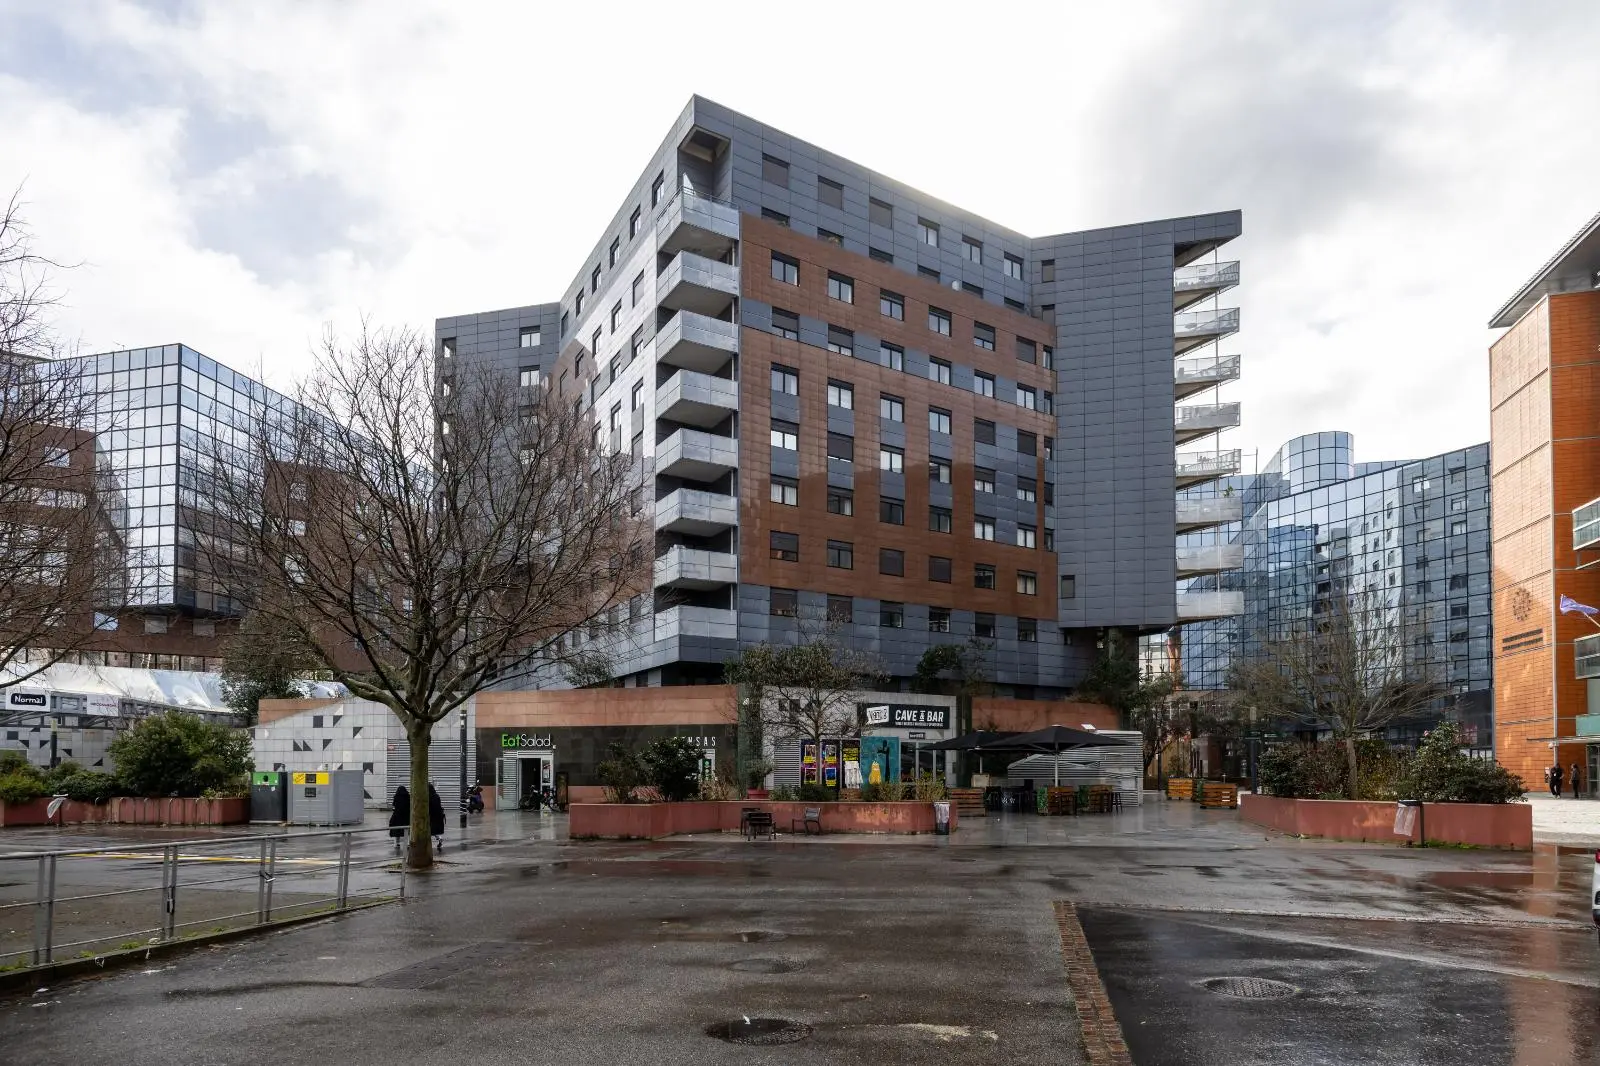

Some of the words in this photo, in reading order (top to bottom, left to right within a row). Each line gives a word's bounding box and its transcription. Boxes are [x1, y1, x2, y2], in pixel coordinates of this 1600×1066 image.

[14, 694, 43, 704] Normal
[895, 709, 918, 722] CAVE
[926, 710, 944, 723] BAR
[501, 733, 551, 747] EatSalad
